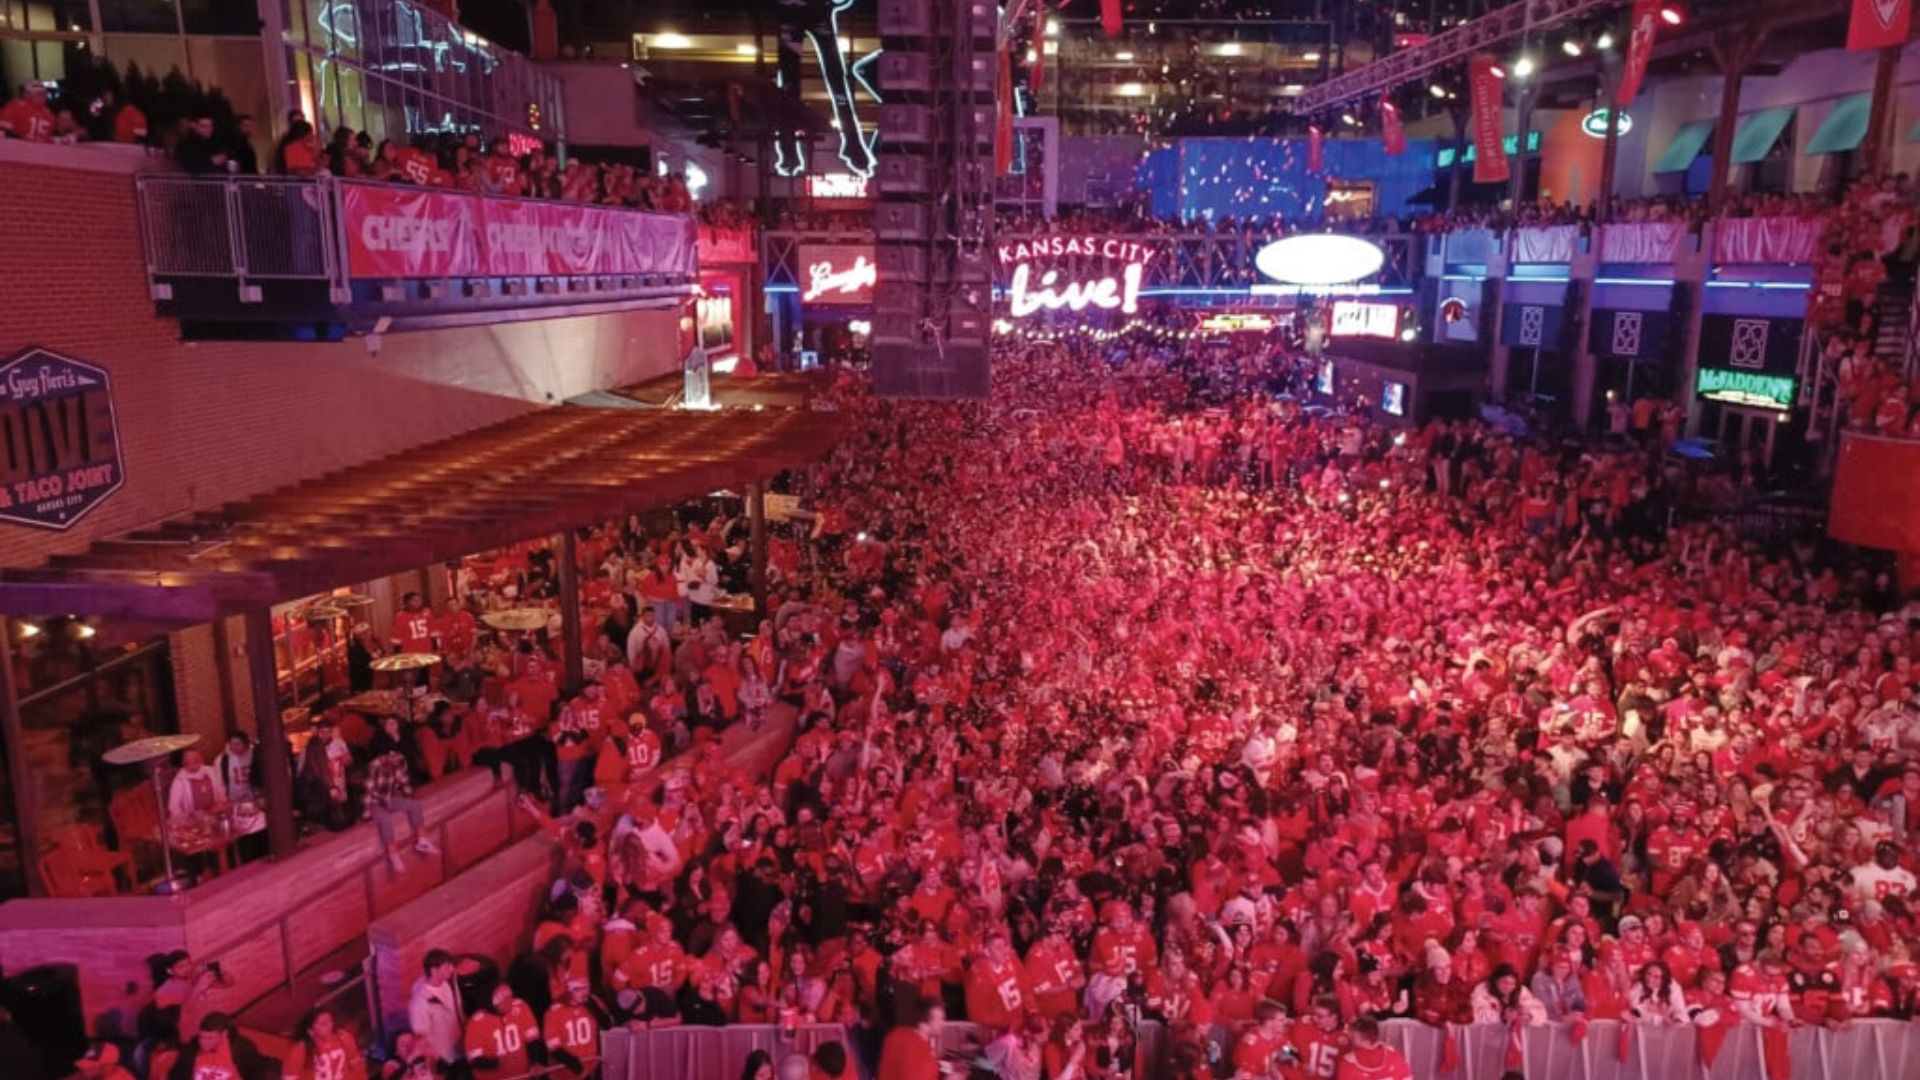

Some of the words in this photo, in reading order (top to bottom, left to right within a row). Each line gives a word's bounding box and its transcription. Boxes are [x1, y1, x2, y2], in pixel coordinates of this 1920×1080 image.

[405, 159, 430, 185] 55
[998, 237, 1096, 263] KANSAS
[1103, 239, 1155, 264] CITY
[1011, 262, 1142, 317] Live!
[8, 367, 39, 399] Guy
[15, 476, 63, 504] TACO
[68, 463, 113, 493] JOINT
[409, 618, 429, 641] 15
[579, 709, 600, 730] 15
[627, 743, 648, 767] 10
[649, 958, 676, 988] 15
[997, 977, 1022, 1012] 15
[492, 1023, 522, 1057] 10
[565, 1016, 592, 1048] 10
[313, 1049, 347, 1080] 87
[1308, 1041, 1339, 1078] 15
